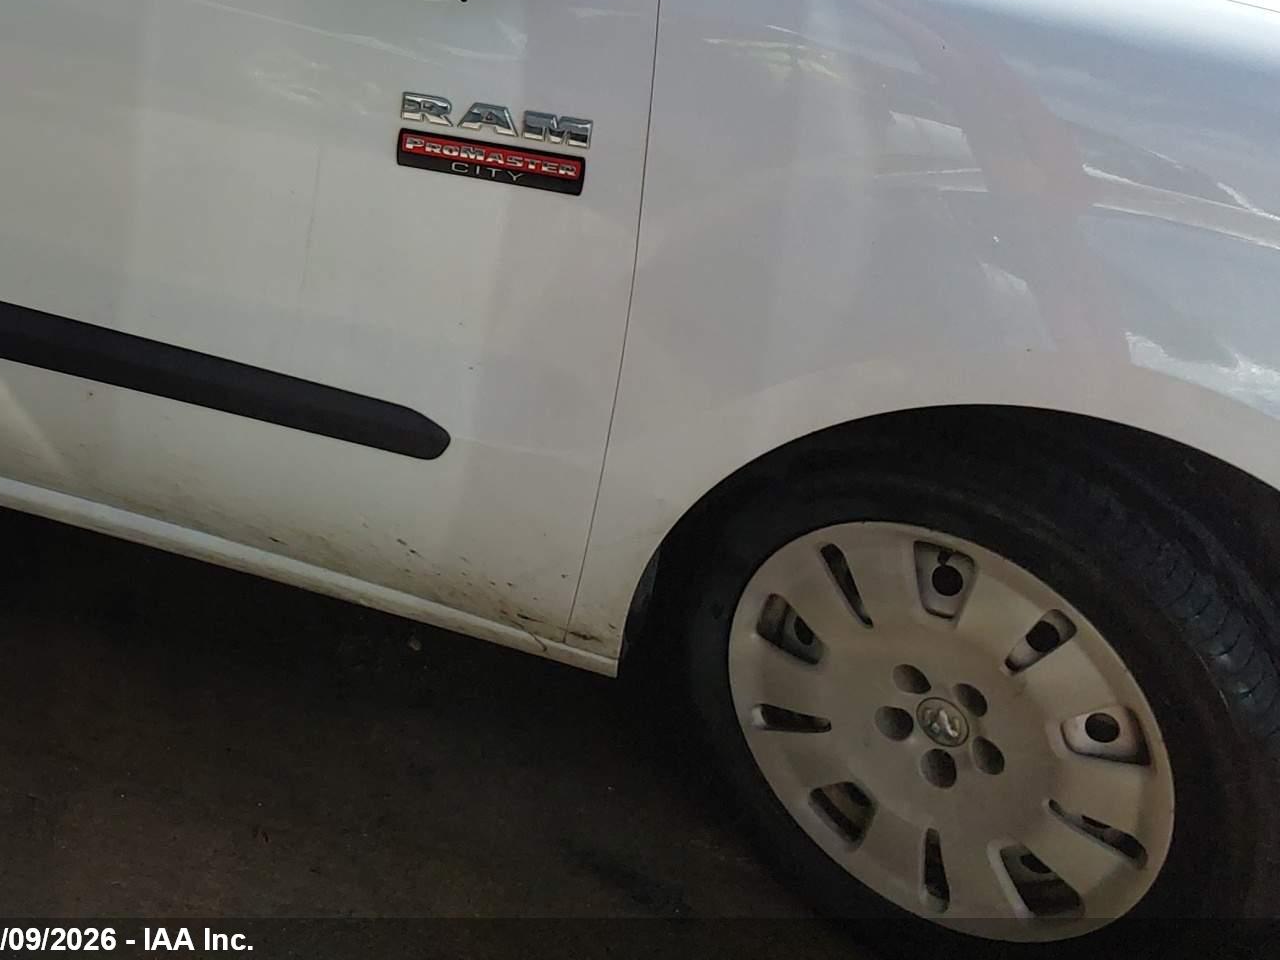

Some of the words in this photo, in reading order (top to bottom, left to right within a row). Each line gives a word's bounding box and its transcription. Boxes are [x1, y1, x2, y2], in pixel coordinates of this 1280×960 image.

[400, 91, 594, 149] RAM
[405, 136, 577, 177] PROMASTER
[451, 162, 524, 182] CITY
